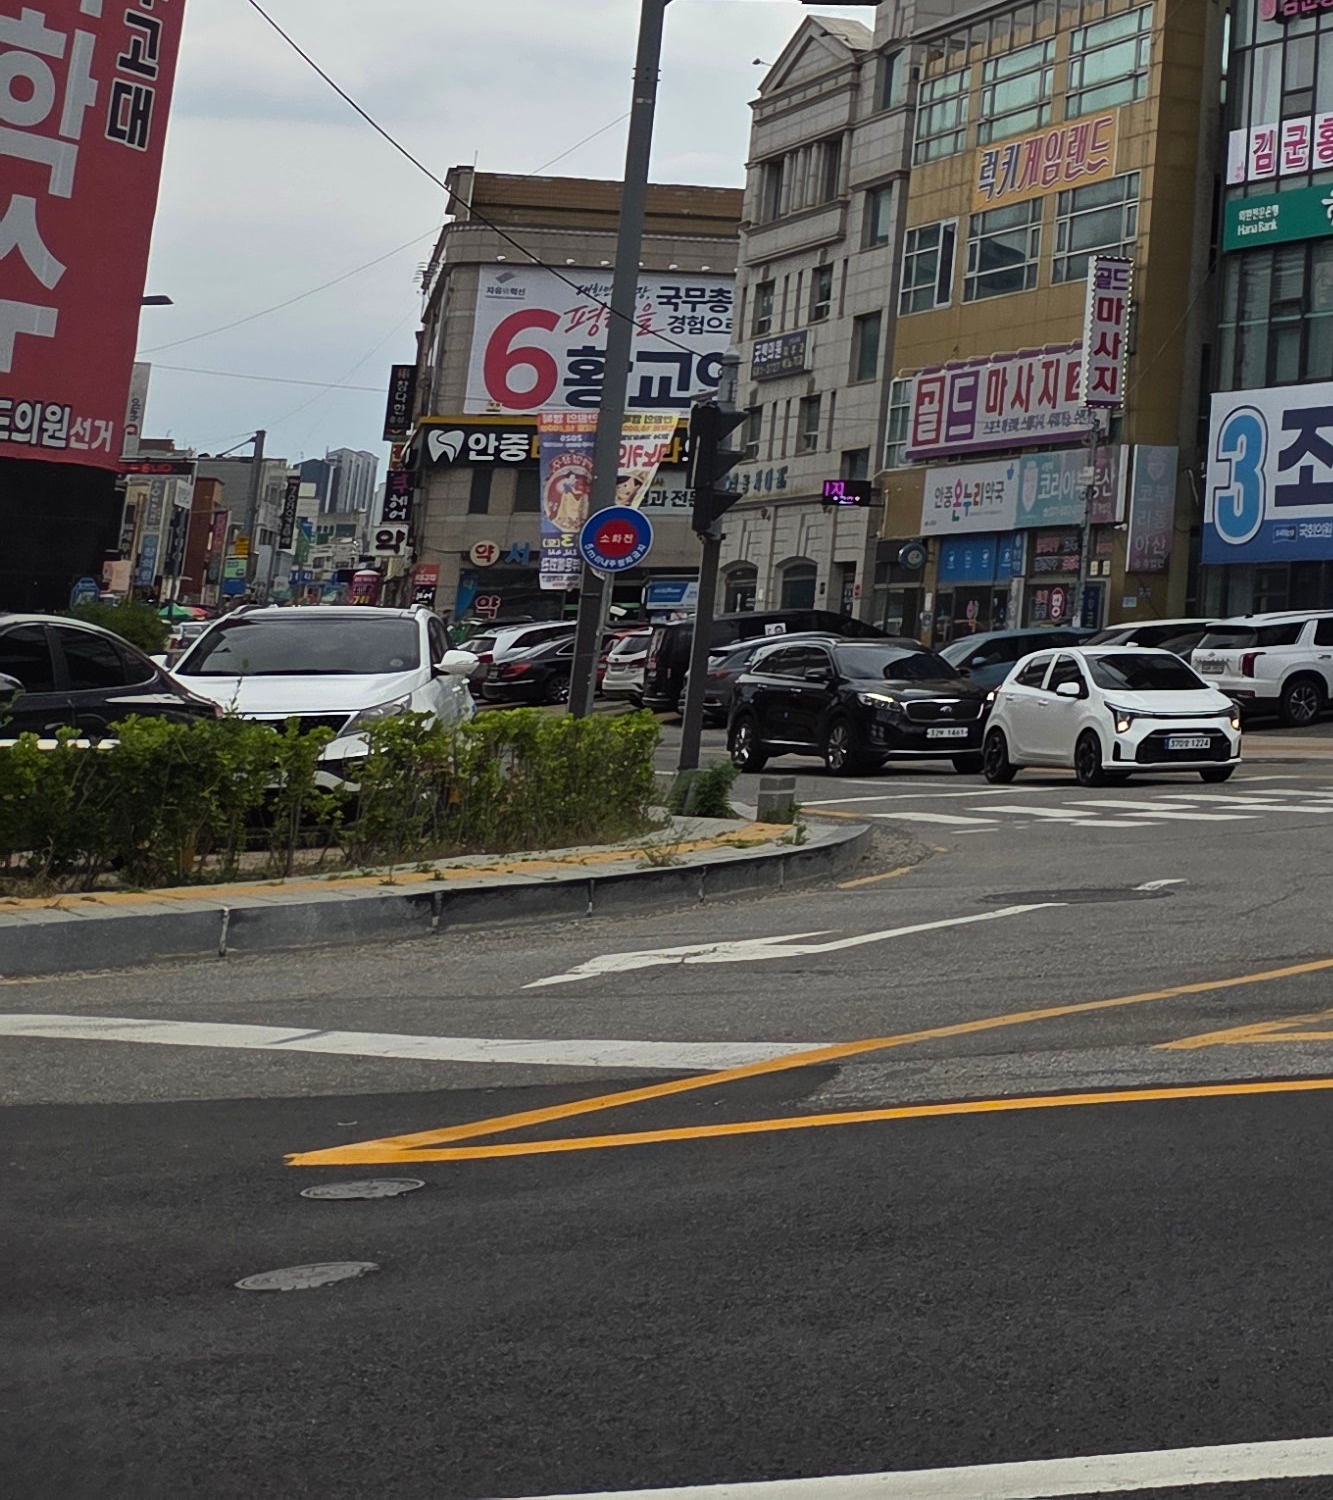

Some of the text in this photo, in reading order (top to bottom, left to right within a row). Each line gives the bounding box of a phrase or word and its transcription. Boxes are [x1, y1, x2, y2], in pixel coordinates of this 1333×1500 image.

[977, 113, 1116, 203] 럭키게임랜드
[1094, 265, 1130, 291] 골드
[483, 308, 562, 411] 6
[1091, 296, 1123, 397] 마사지
[912, 371, 982, 448] 골드
[984, 357, 1058, 417] 마사지
[1213, 405, 1268, 546] 3
[375, 528, 405, 555] 약
[474, 542, 496, 561] 약
[599, 533, 635, 545] 소화전
[475, 595, 501, 619] 약
